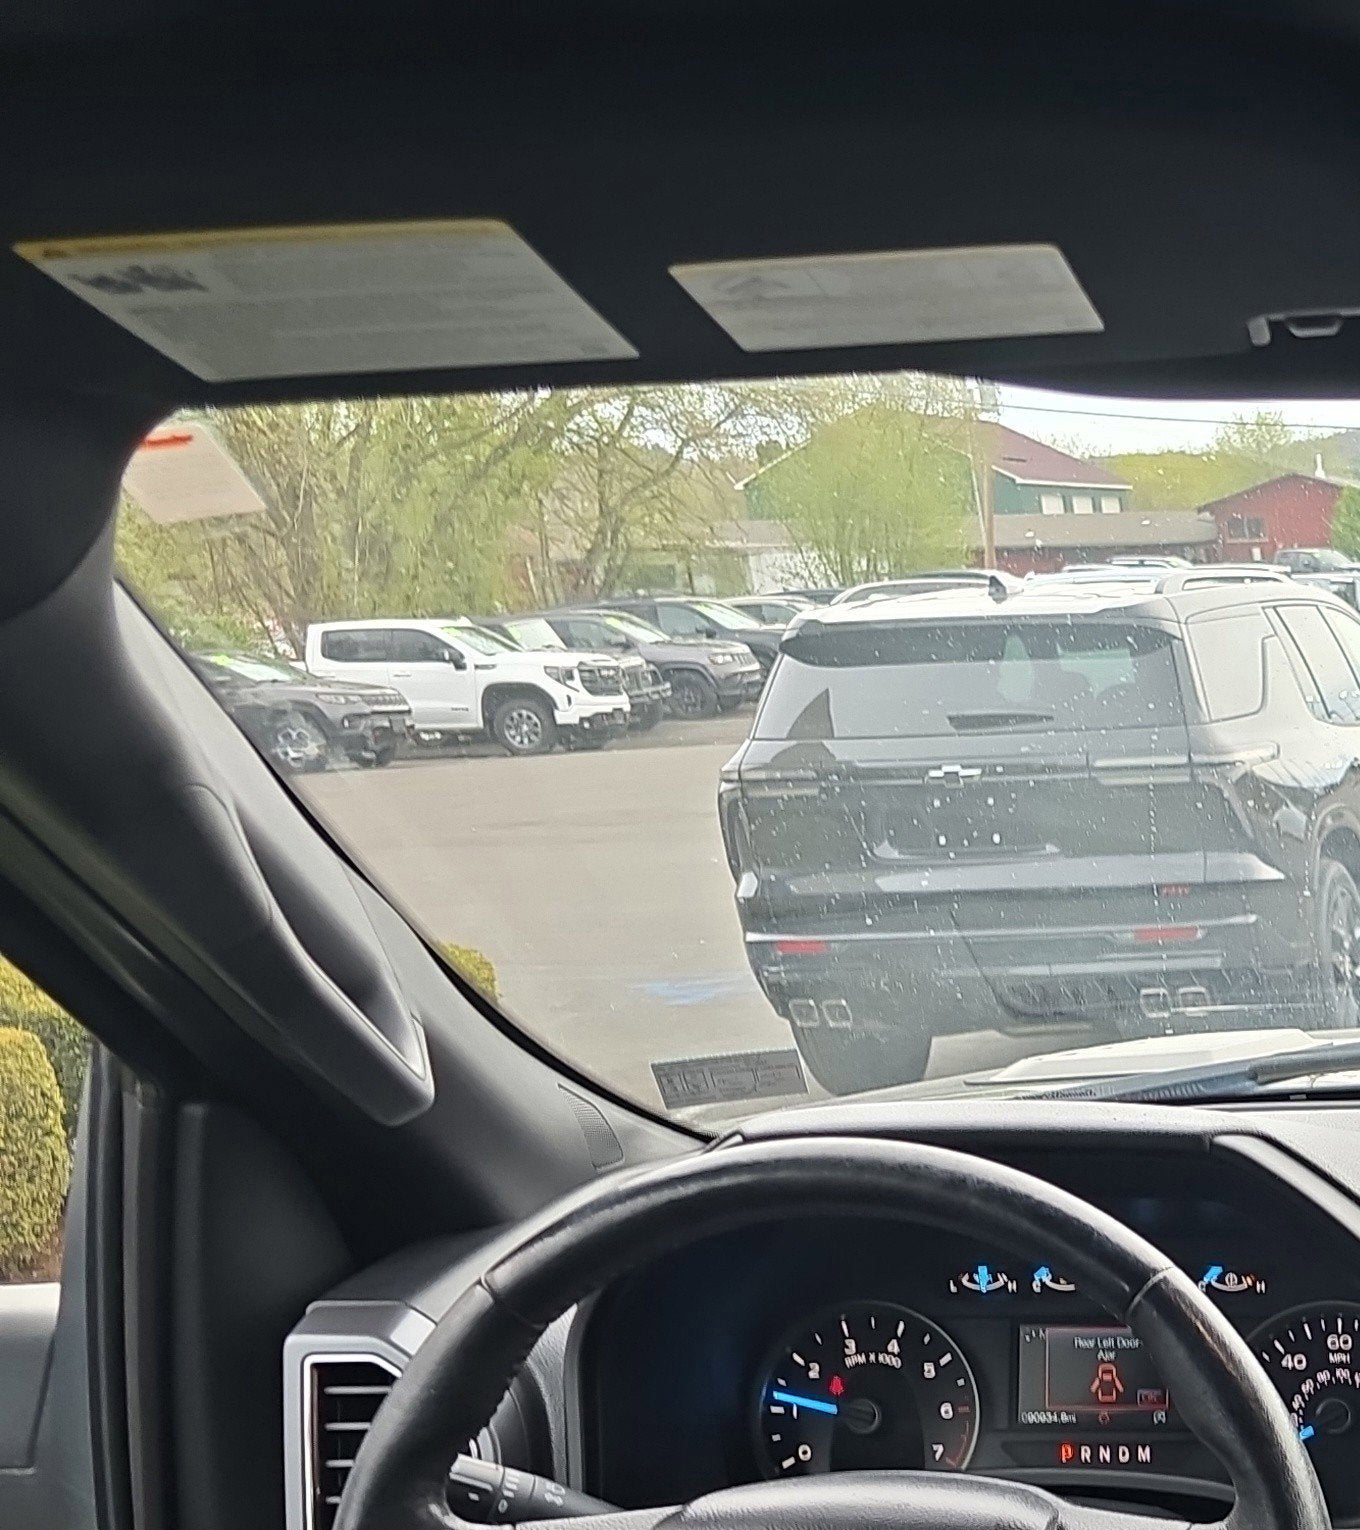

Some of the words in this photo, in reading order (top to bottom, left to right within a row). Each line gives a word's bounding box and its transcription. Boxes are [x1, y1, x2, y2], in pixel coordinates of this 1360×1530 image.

[844, 1339, 856, 1355] 3
[887, 1338, 899, 1355] 4
[1327, 1334, 1352, 1351] 60
[1281, 1353, 1307, 1370] 40
[808, 1362, 820, 1379] 2
[923, 1362, 936, 1379] 5
[940, 1402, 954, 1420] 6
[798, 1444, 811, 1461] 0
[932, 1444, 944, 1461] 7
[1081, 1445, 1091, 1463] R
[1099, 1445, 1111, 1463] N
[1119, 1445, 1130, 1463] D
[1138, 1445, 1150, 1463] M
